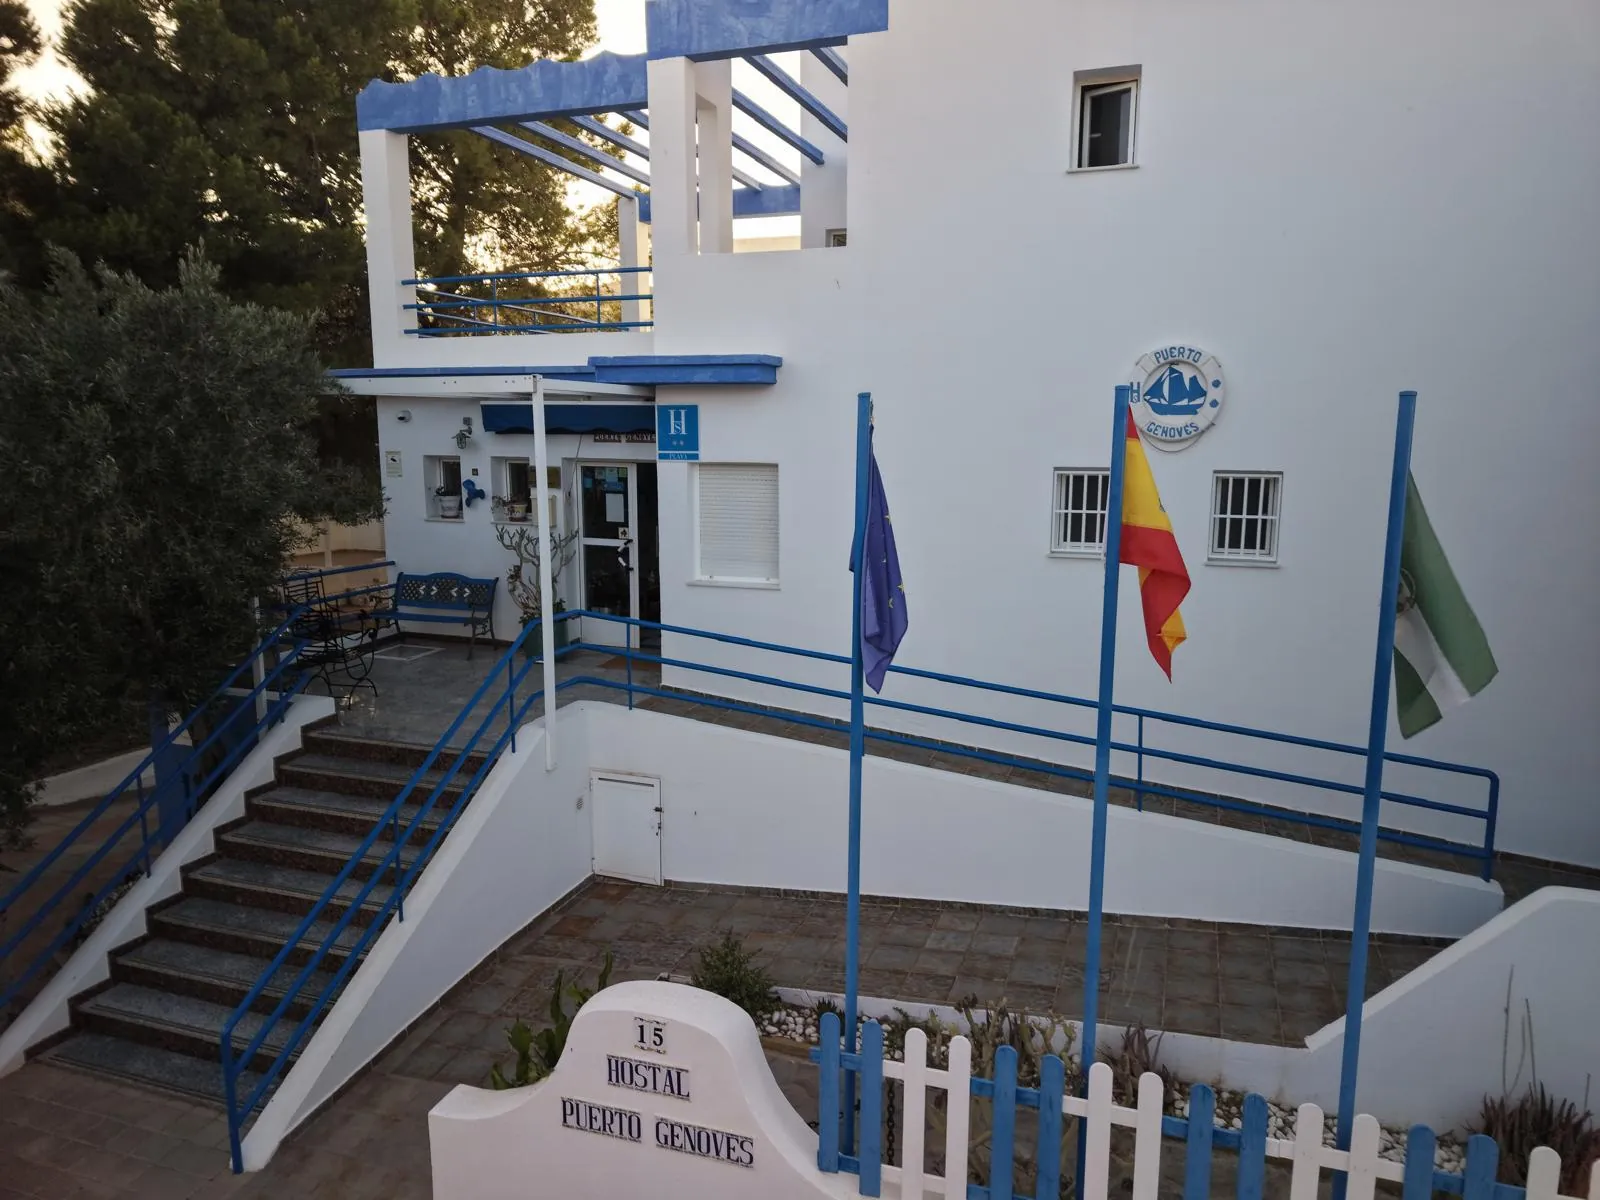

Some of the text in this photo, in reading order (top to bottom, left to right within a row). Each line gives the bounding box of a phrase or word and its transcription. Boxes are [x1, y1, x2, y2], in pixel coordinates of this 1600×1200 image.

[1154, 346, 1202, 364] PUERTO
[1146, 421, 1200, 438] GENOVES
[637, 1024, 664, 1047] 15
[607, 1057, 690, 1098] HOSTAL
[562, 1099, 754, 1165] PUERTO GENOVES
